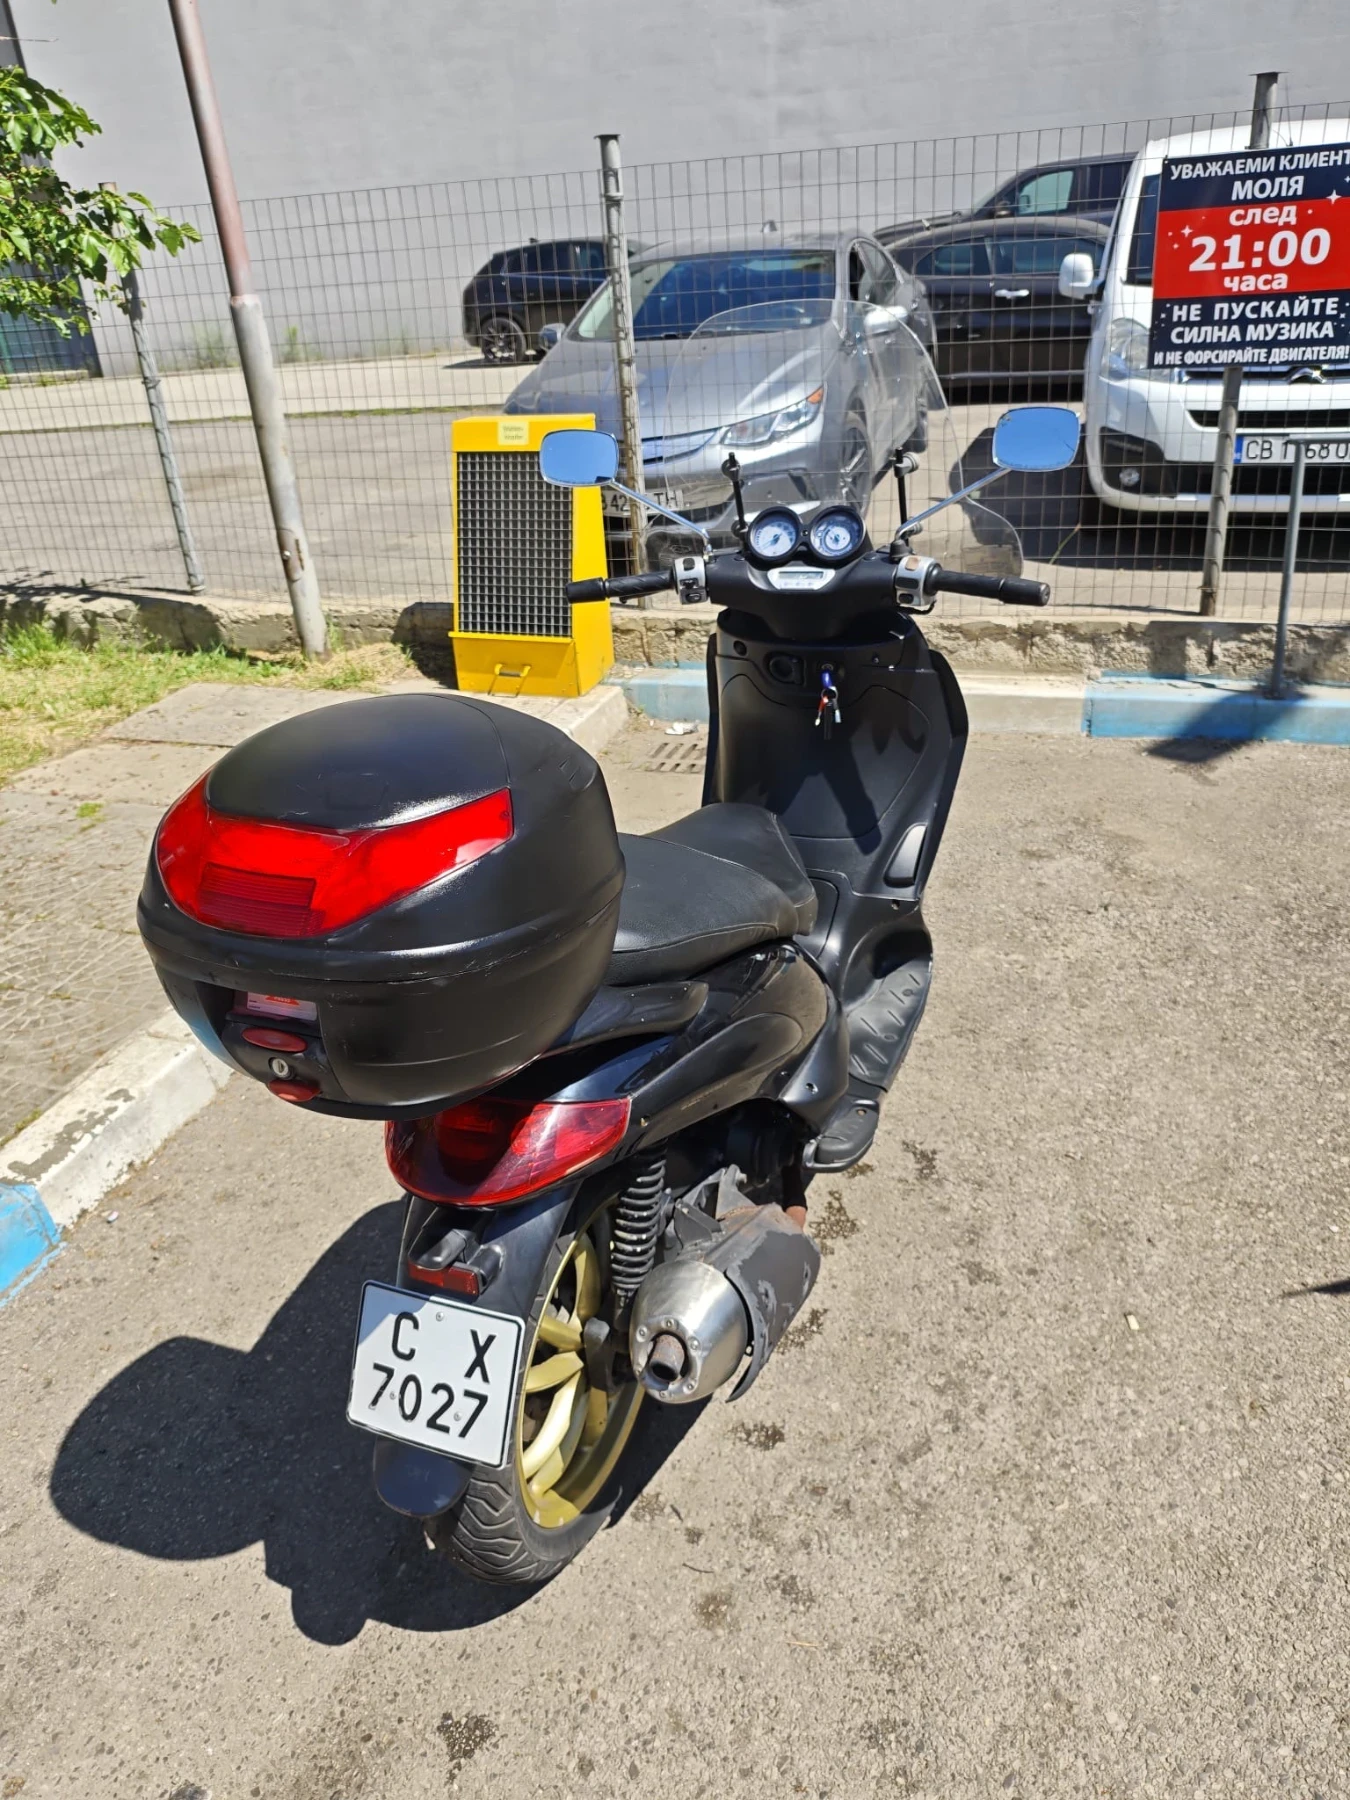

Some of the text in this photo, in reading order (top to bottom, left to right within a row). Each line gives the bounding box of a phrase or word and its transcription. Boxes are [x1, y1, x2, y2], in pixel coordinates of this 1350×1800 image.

[1170, 156, 1275, 180] УВАЖАЕМИ
[1231, 175, 1304, 201] МОЛЯ
[1229, 205, 1297, 226] след
[1188, 227, 1331, 272] 21:00
[1223, 272, 1288, 292] часа
[1172, 296, 1339, 322] НЕ ПУСКАЙТЕ
[1170, 321, 1335, 344] СИЛНА МУЗИКА
[1154, 352, 1163, 365] И
[1166, 352, 1182, 365] НЕ
[1184, 347, 1267, 365] ФОРСИРАЙТЕ
[391, 1311, 496, 1384] C X
[367, 1362, 488, 1438] 7027
